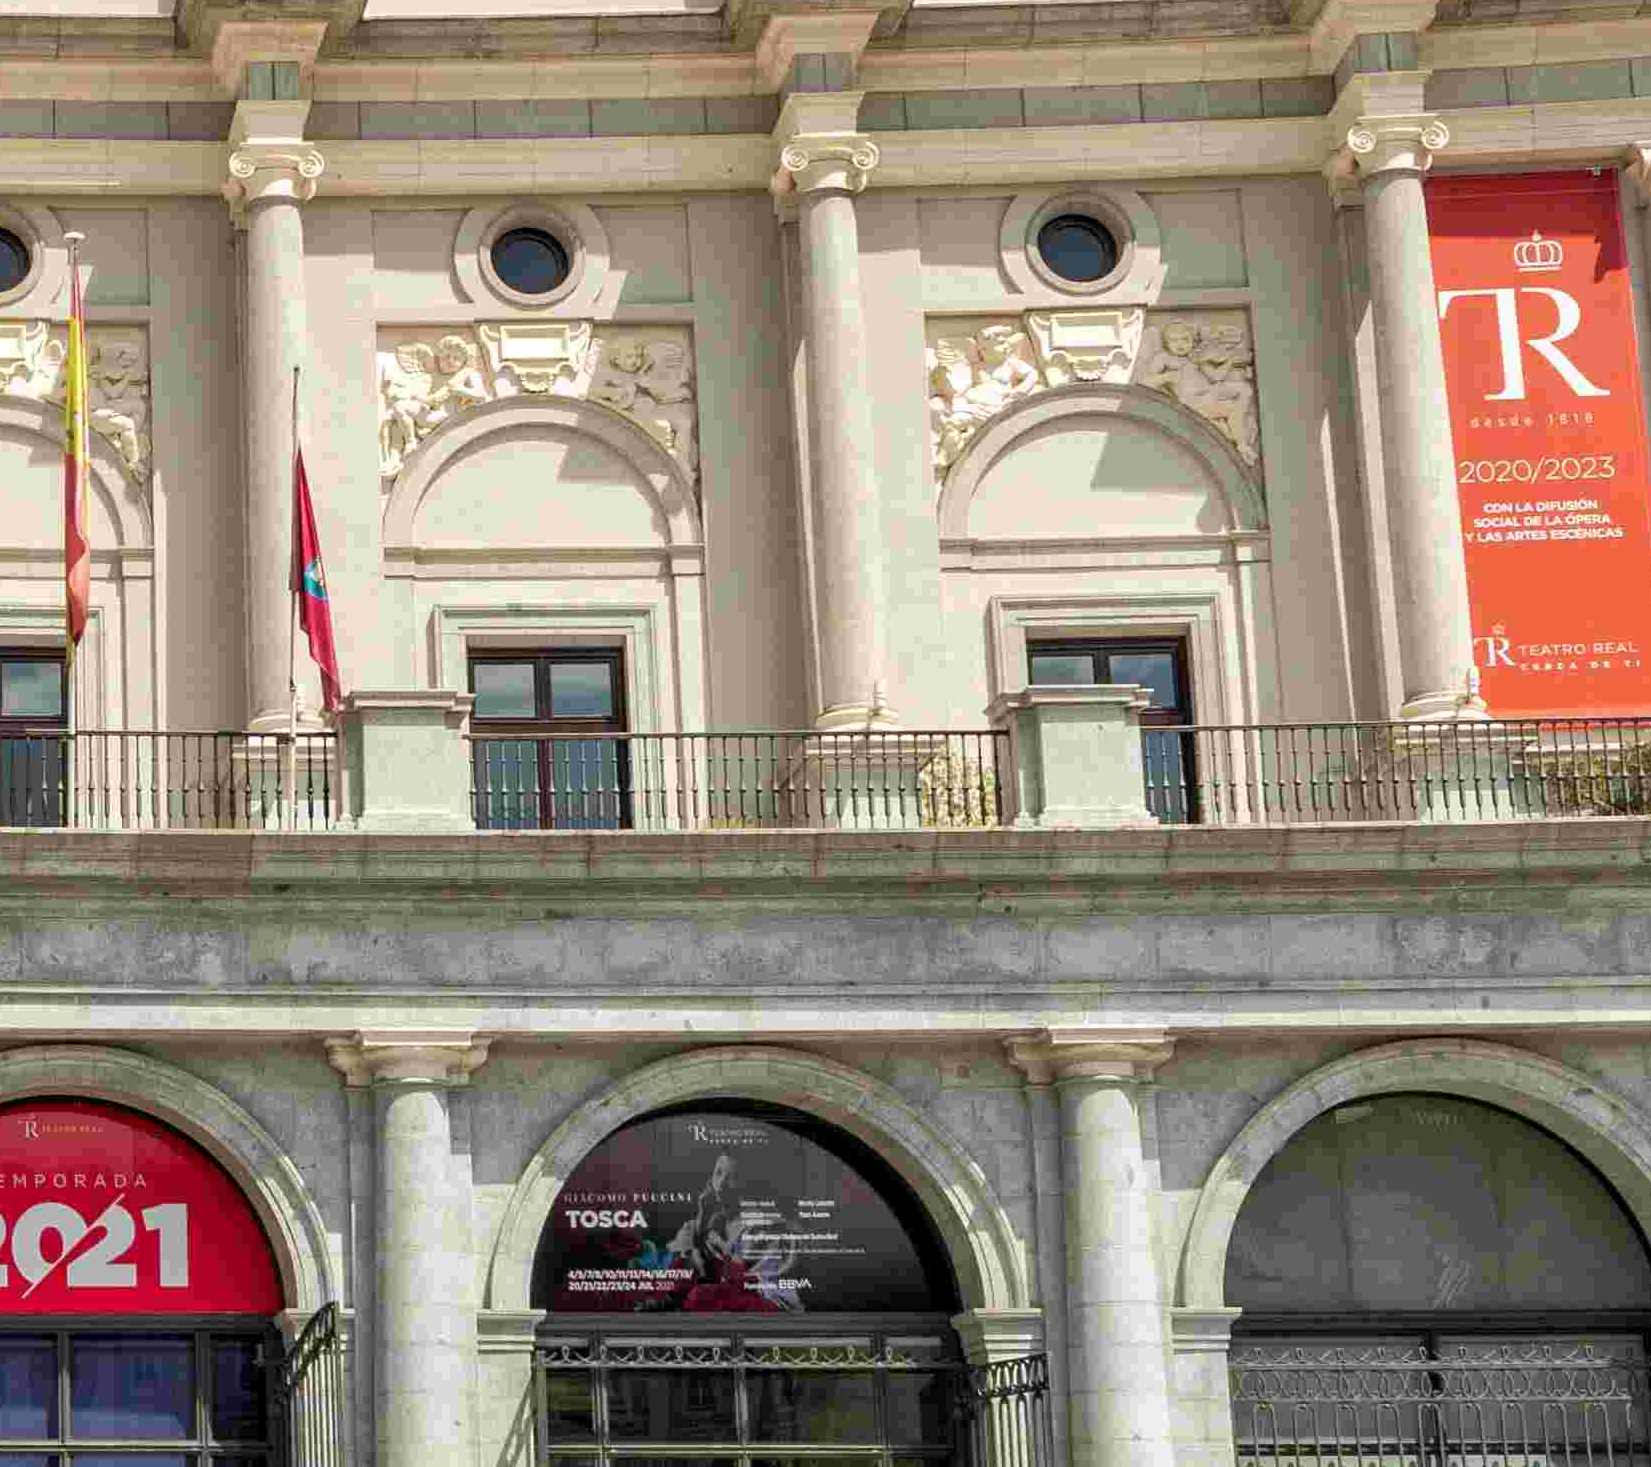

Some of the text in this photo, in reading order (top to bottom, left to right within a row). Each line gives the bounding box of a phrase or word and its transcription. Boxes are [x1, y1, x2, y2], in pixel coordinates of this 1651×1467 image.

[1471, 412, 1595, 428] desde 1818
[1457, 456, 1616, 484] 2020/2023
[1482, 497, 1598, 513] CON LA DIFUSIÓN
[1474, 511, 1612, 528] SOCIAL DE LA ÓPERA
[1465, 532, 1474, 542] Y
[1477, 531, 1504, 542] LAS
[1506, 531, 1547, 541] ARTES
[1518, 641, 1639, 656] TEATRO REAL
[565, 1209, 648, 1228] TOSCA
[778, 1278, 813, 1290] BBVA
